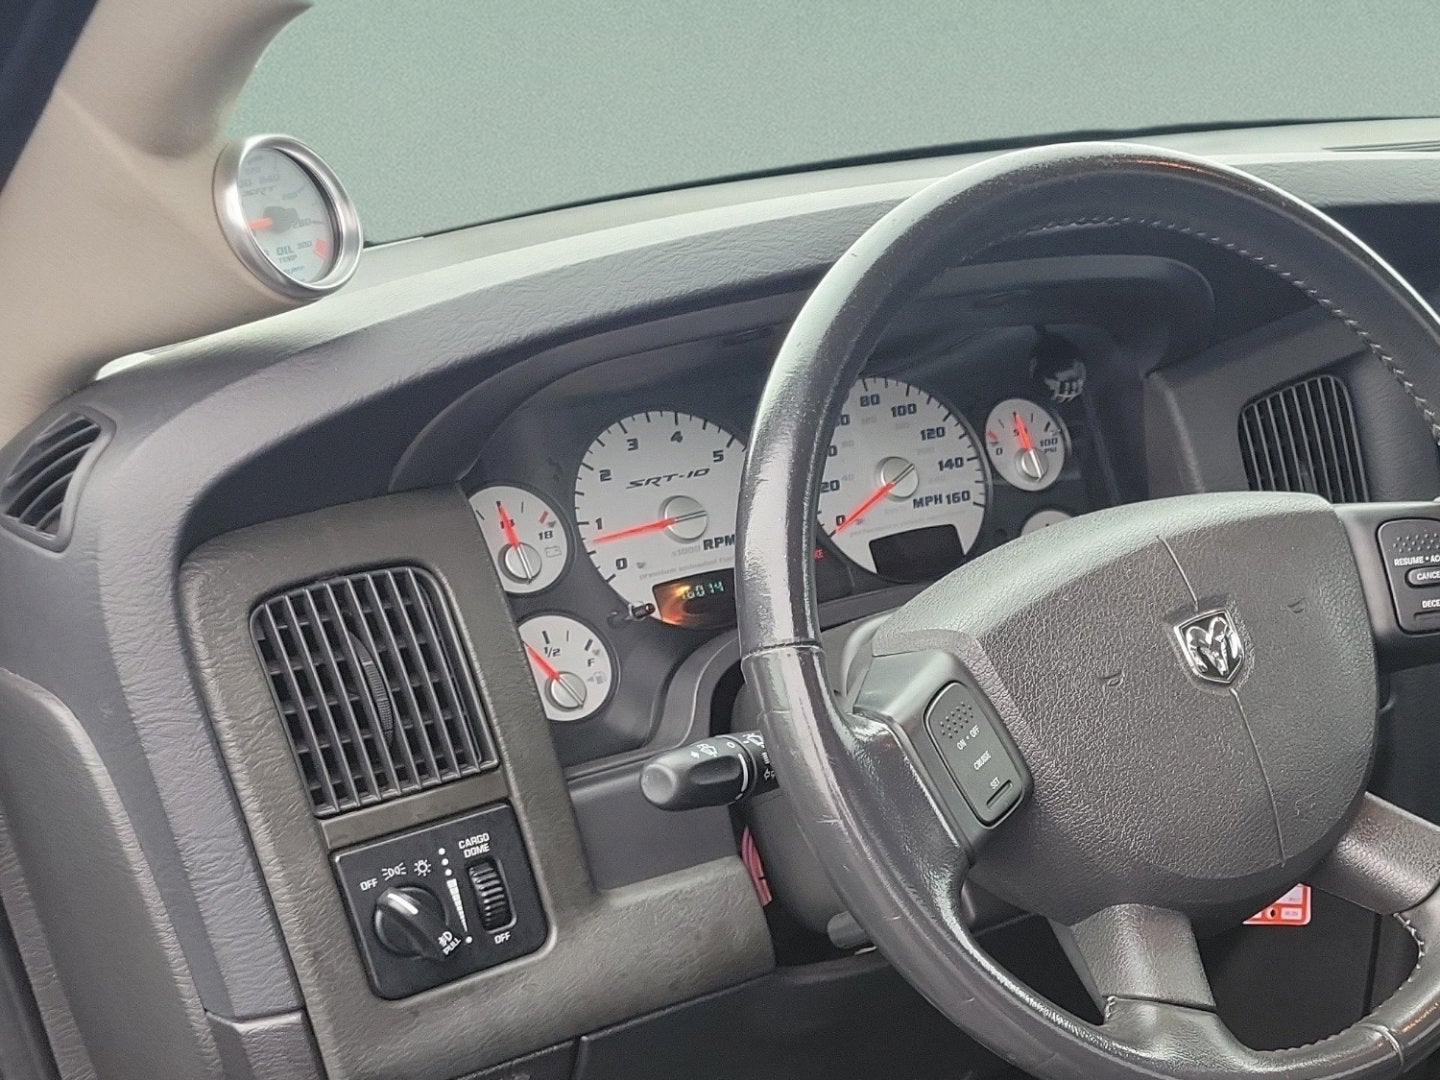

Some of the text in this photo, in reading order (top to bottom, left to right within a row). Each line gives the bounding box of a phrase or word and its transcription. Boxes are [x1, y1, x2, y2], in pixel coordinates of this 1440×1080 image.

[860, 393, 880, 408] 80
[890, 403, 917, 418] 100
[670, 430, 683, 443] 4
[920, 427, 946, 441] 120
[626, 438, 639, 451] 3
[712, 450, 724, 463] 5
[937, 457, 965, 471] 140
[599, 469, 612, 482] 2
[626, 468, 711, 489] SRT-10
[913, 494, 943, 510] MPH
[946, 490, 971, 505] 160
[595, 517, 603, 530] 1
[538, 530, 553, 541] 18
[703, 534, 735, 551] RPM
[615, 557, 628, 570] 0
[1394, 556, 1425, 566] RESUME
[543, 646, 561, 658] 1/2
[587, 658, 595, 667] F
[956, 724, 981, 750] ON OFF
[973, 750, 992, 771] CRUISE
[990, 776, 1001, 790] SET
[458, 832, 490, 850] CARGO
[464, 842, 491, 859] DOME
[360, 877, 378, 891] OFF
[494, 931, 511, 945] OFF
[442, 937, 461, 956] PULL
